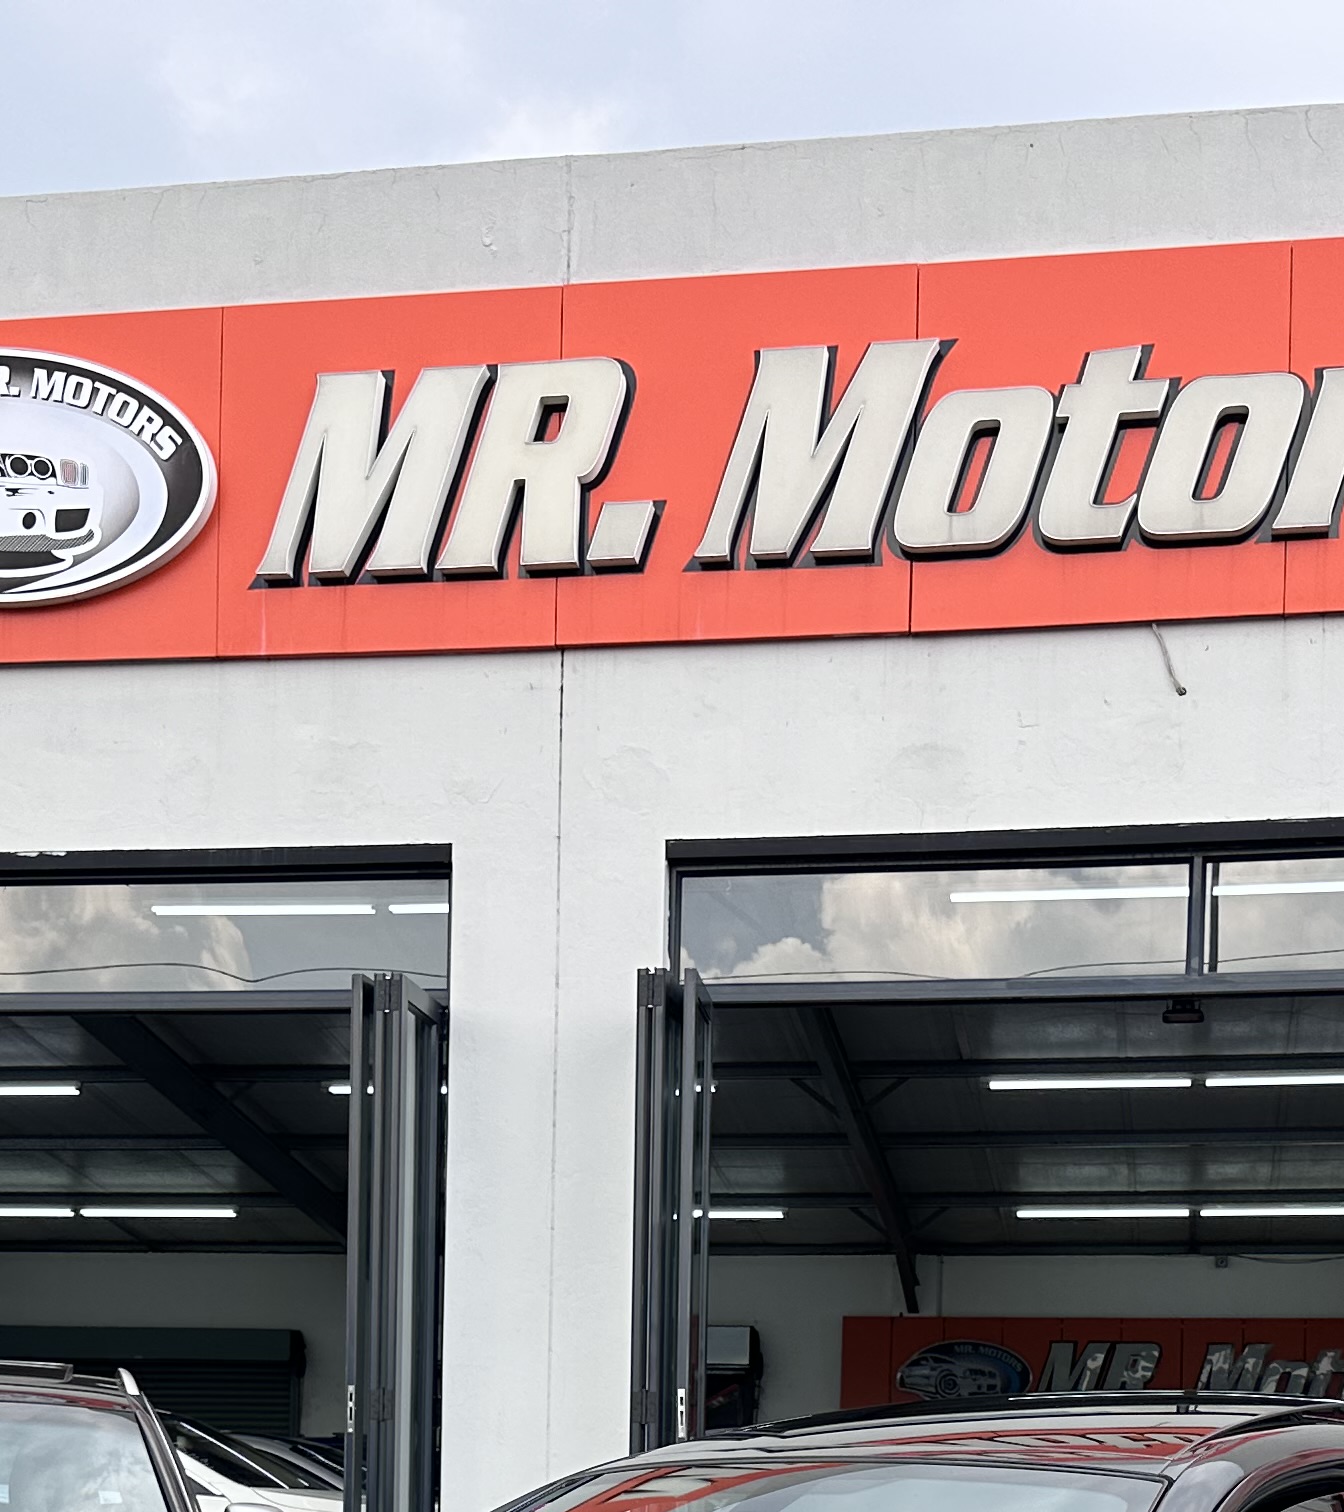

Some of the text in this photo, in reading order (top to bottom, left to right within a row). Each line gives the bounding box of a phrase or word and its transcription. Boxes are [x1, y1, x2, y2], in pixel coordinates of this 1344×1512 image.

[31, 367, 185, 461] MOTORS
[253, 357, 660, 582] MR.
[979, 1346, 1023, 1372] MOTORS
